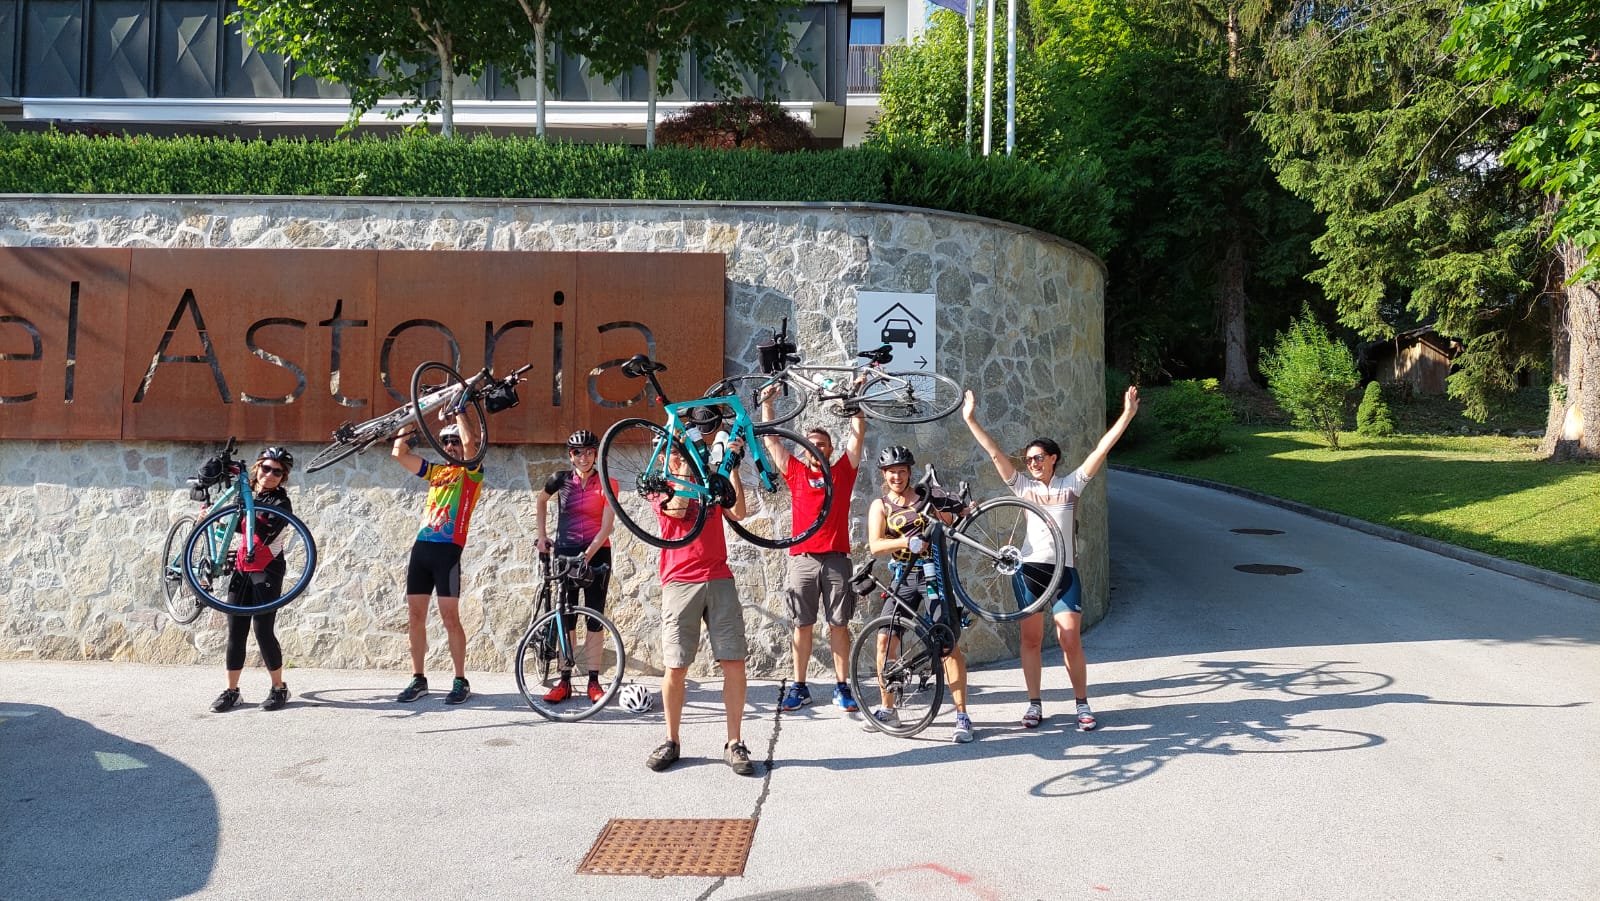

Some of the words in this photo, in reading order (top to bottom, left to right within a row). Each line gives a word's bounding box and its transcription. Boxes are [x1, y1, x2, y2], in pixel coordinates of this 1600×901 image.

[132, 288, 657, 409] Astoria
[724, 425, 747, 473] Biahi
[931, 543, 945, 601] SPECIALIZED
